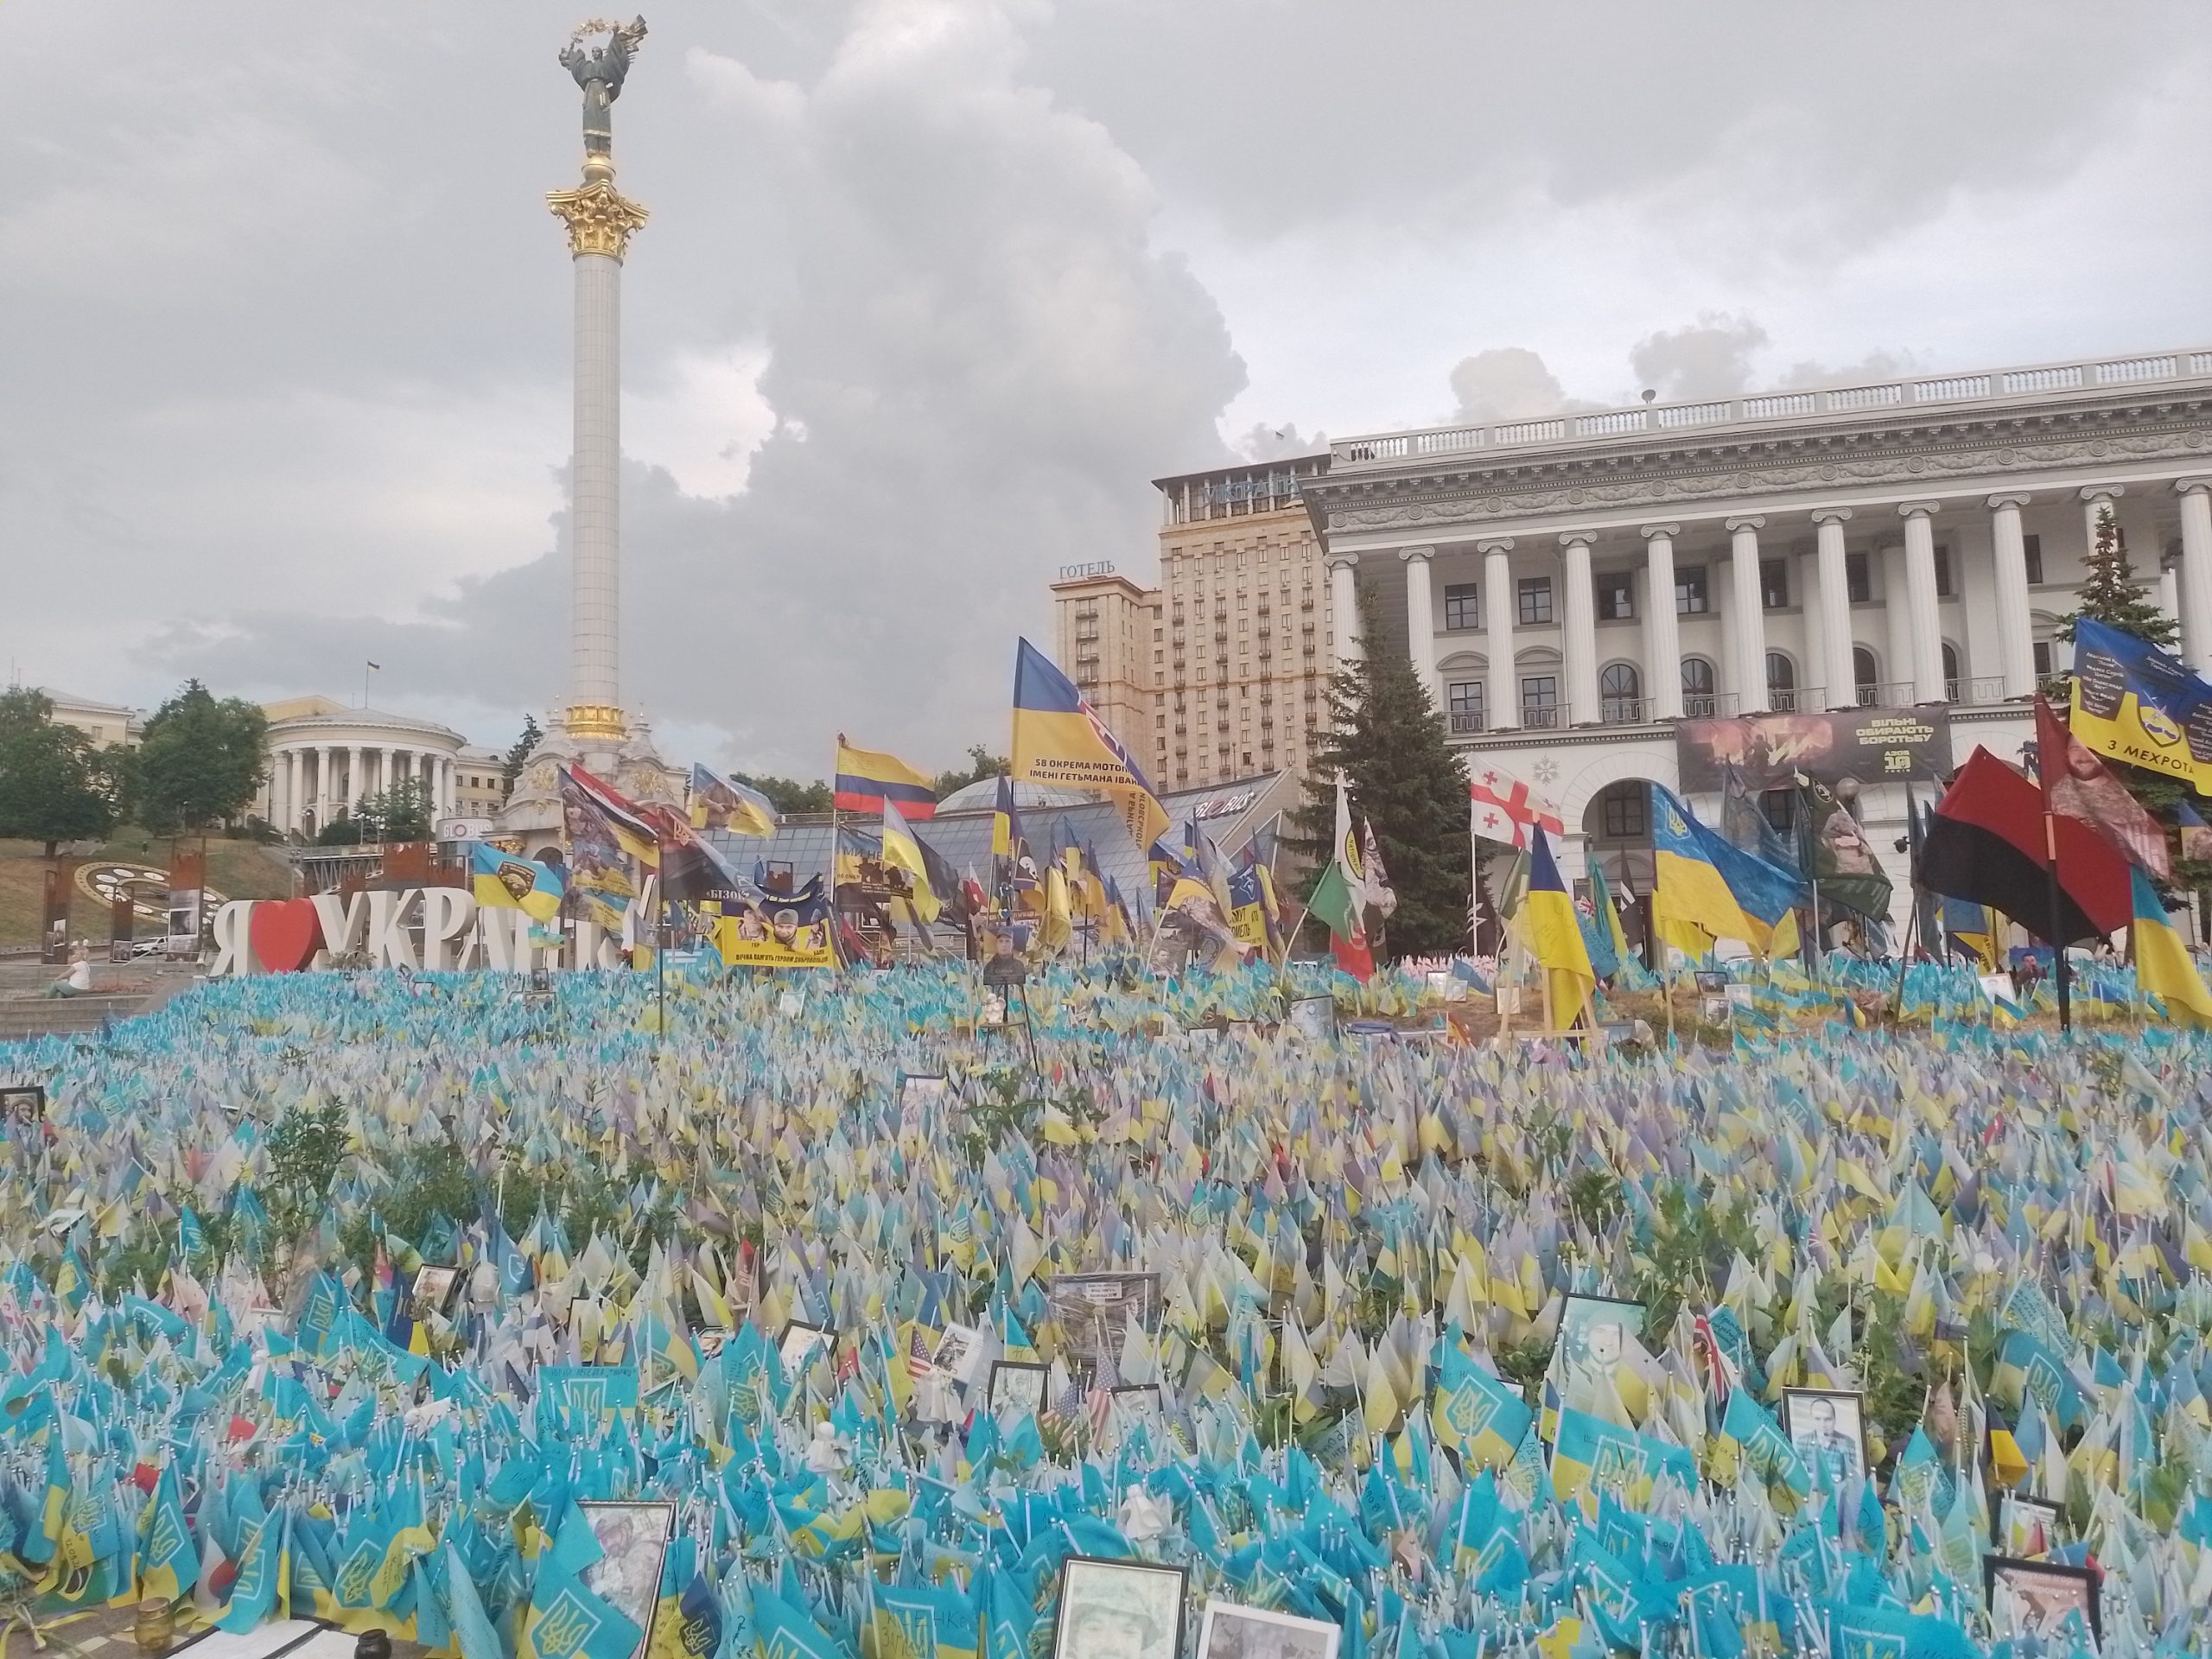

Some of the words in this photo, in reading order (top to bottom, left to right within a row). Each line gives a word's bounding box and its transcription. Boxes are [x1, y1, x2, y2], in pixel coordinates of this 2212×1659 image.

[1059, 561, 1116, 580] ГОТЕЛЬ
[1871, 718, 1916, 728] ВІЛЬНІ
[1855, 726, 1935, 737] ОБИРАЮТЬ
[1859, 734, 1932, 745] БОРОТЬБУ
[1035, 759, 1046, 767] 58
[1049, 760, 1090, 770] ОКРЕМА
[1885, 756, 1911, 770] 10
[2123, 745, 2195, 774] МЕХРОТА
[1030, 769, 1058, 779] ІМЕНІ
[1060, 772, 1113, 784] ГЕТЬМАНА
[1115, 776, 1141, 785] ІВАН
[1195, 791, 1255, 818] GLOBUS
[443, 823, 493, 838] GLOBUS
[1350, 838, 1361, 871] NATIONAL
[213, 899, 262, 976] Я
